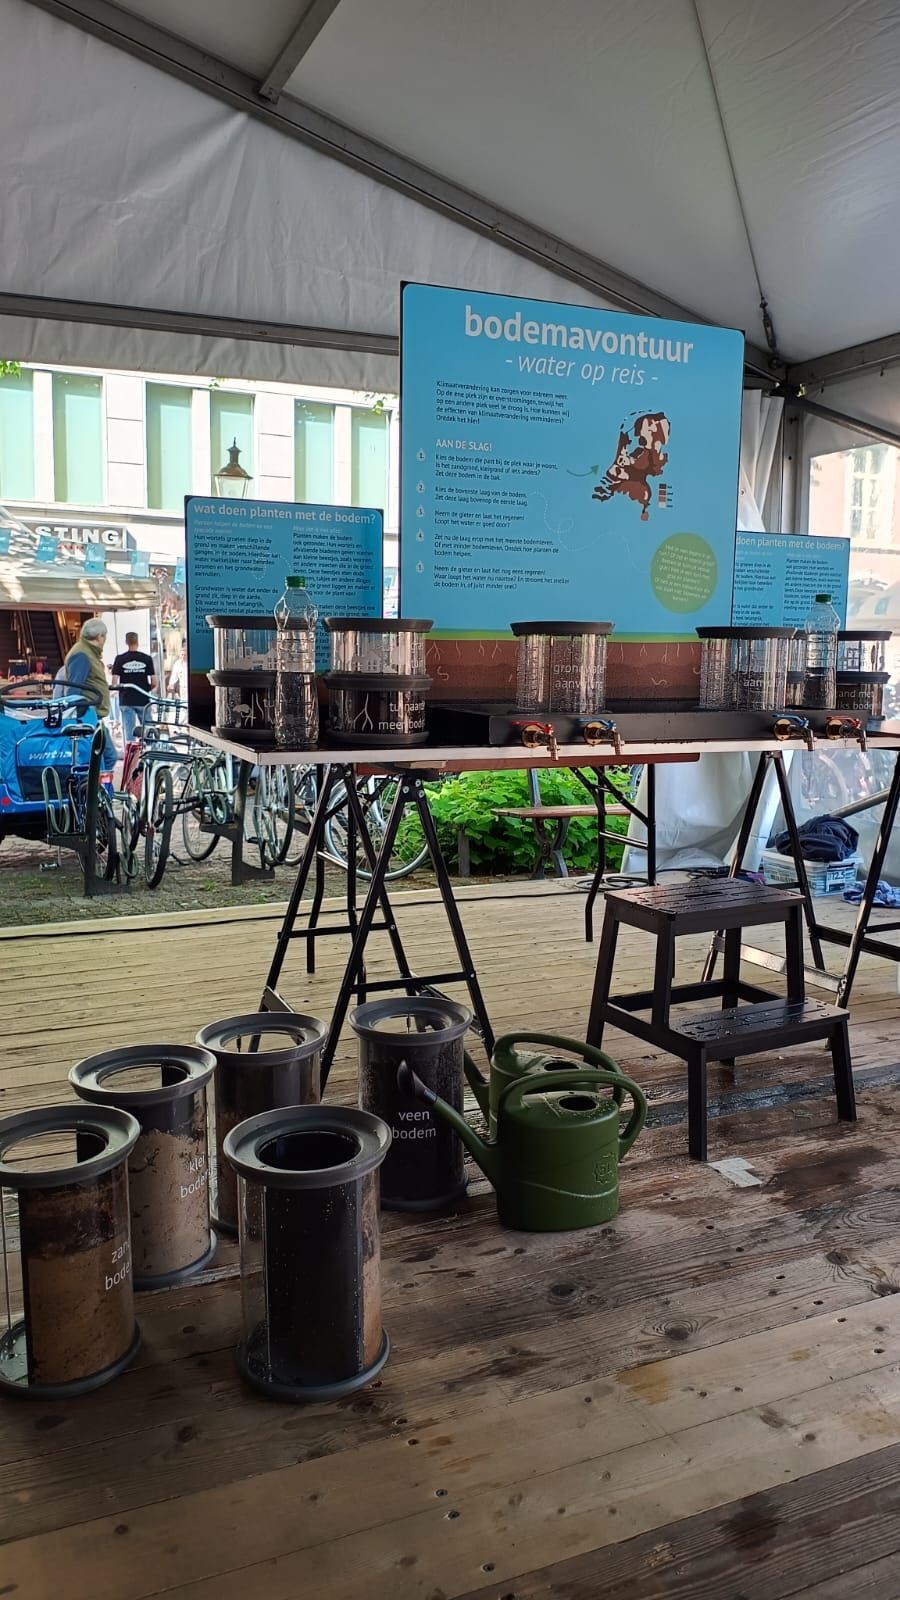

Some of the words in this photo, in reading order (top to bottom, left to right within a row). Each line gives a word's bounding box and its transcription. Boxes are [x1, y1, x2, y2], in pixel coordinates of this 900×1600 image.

[465, 304, 694, 363] bodemavontuur
[518, 355, 575, 377] water
[581, 362, 604, 385] op
[611, 363, 646, 386] reis
[436, 440, 454, 449] AAN
[455, 441, 466, 450] DE
[469, 442, 492, 452] SLAG!
[193, 504, 215, 514] wat
[218, 504, 247, 517] doen
[250, 506, 292, 519] planten
[295, 511, 317, 521] met
[319, 511, 332, 522] de
[335, 512, 376, 524] bodem?
[35, 526, 120, 545] STING
[736, 536, 756, 545] doen
[757, 537, 787, 548] planten
[788, 539, 804, 548] met
[805, 540, 816, 549] de
[398, 1110, 430, 1121] veen
[392, 1126, 437, 1139] bodem
[188, 1152, 205, 1173] klei
[111, 1241, 131, 1264] zan
[105, 1261, 131, 1290] bode
